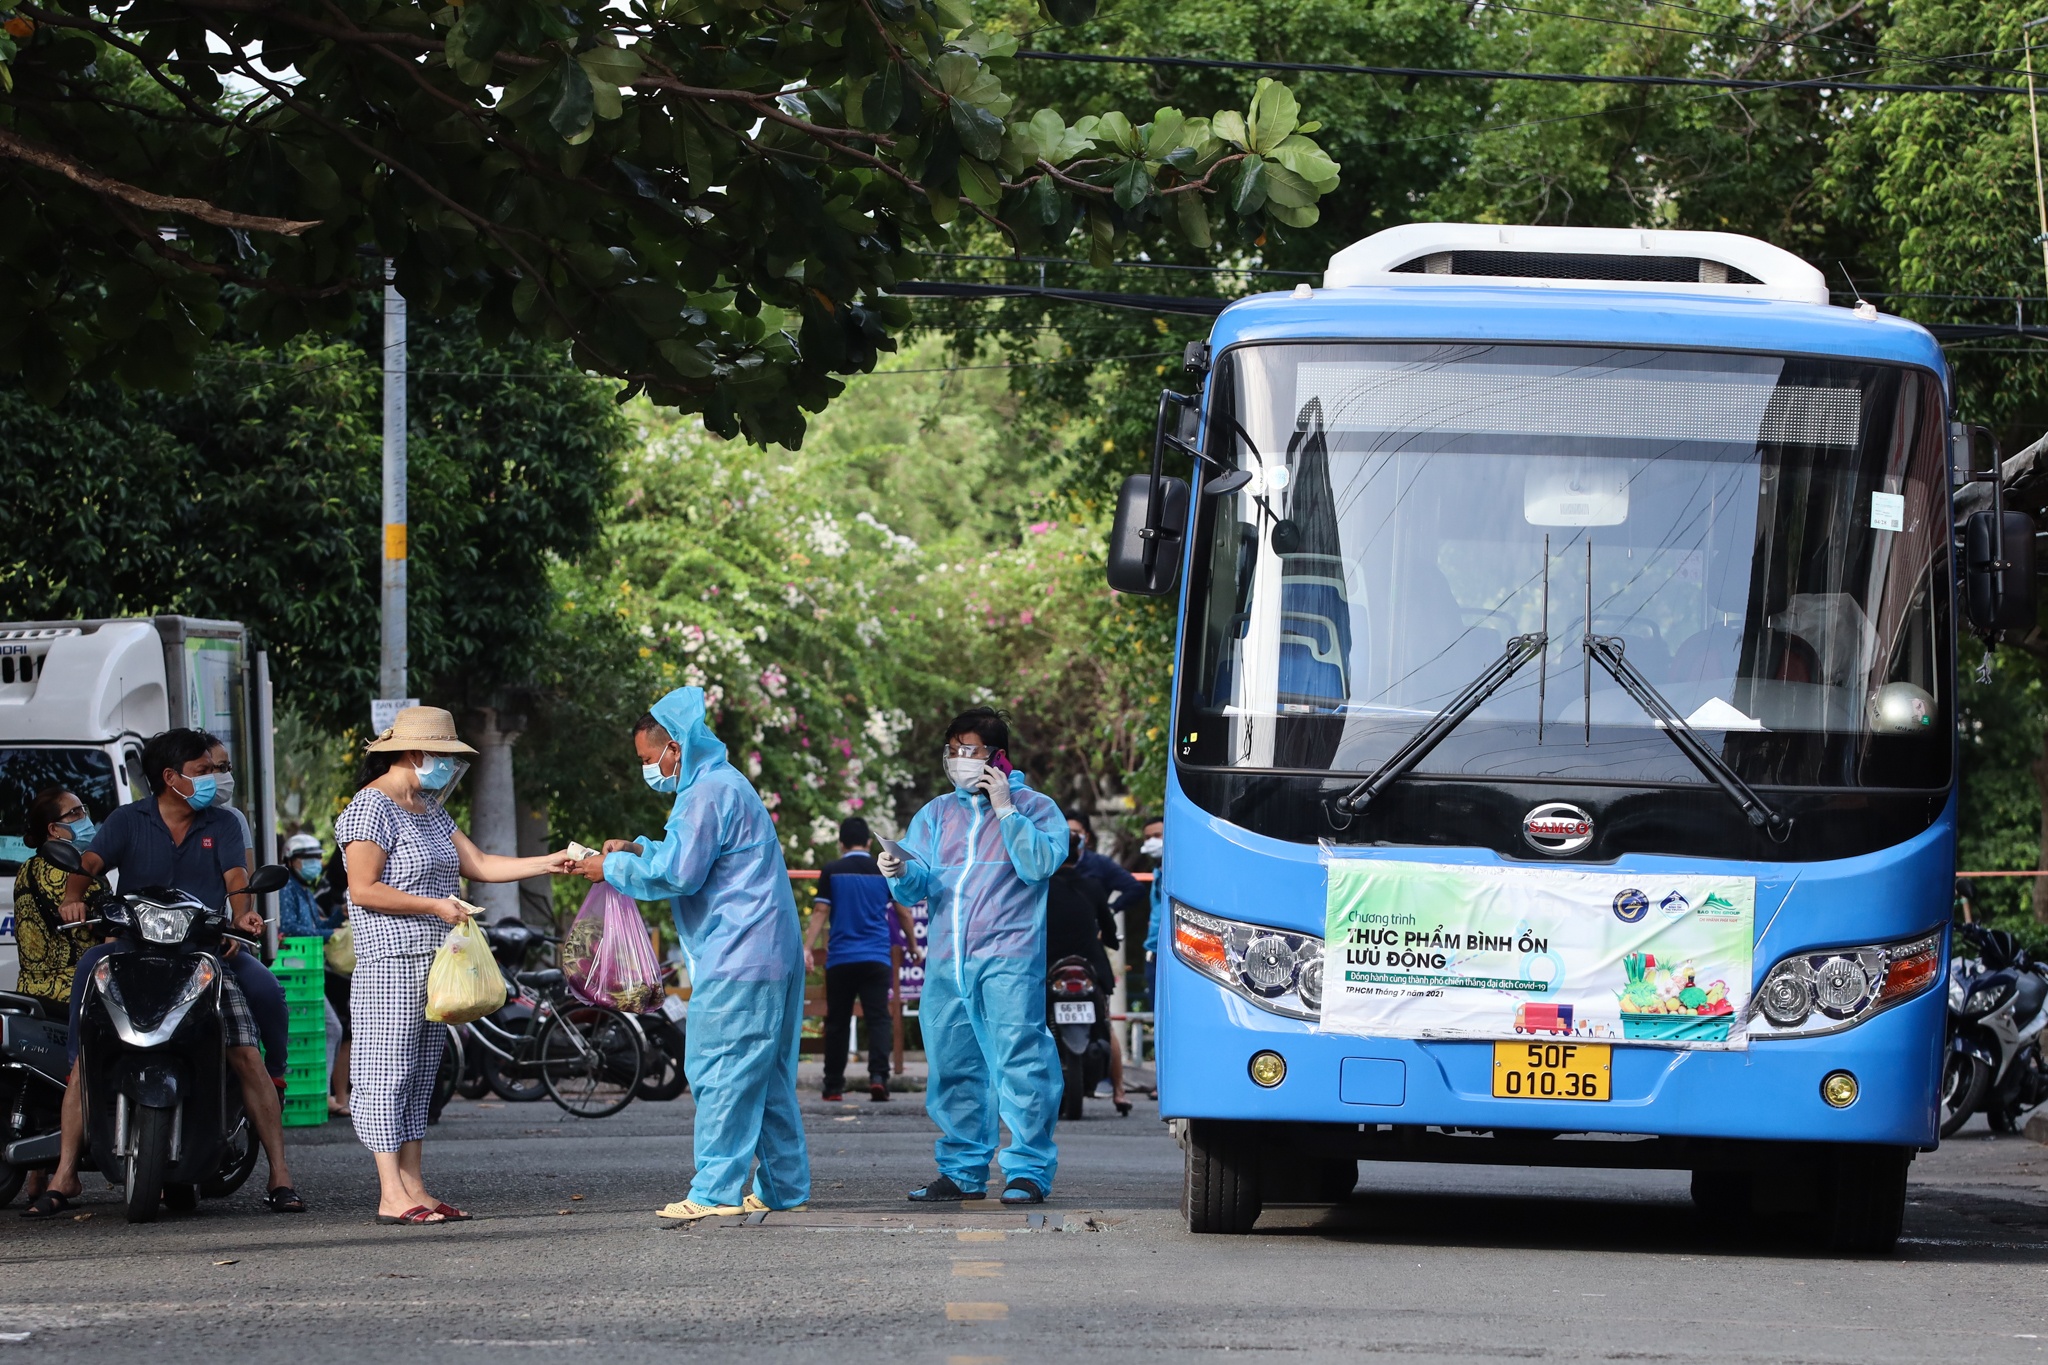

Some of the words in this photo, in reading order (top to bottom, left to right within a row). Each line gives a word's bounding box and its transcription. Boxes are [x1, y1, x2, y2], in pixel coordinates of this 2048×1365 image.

[0, 645, 27, 655] DAI
[1529, 820, 1589, 835] SAMCO
[1348, 910, 1388, 927] Chương
[1391, 912, 1416, 925] trình
[1348, 928, 1398, 949] THỰC
[1405, 924, 1460, 949] PHẨM
[1467, 931, 1512, 952] BÌNH
[1518, 929, 1548, 953] ỔN
[1347, 948, 1380, 966] LƯU
[1386, 948, 1446, 972] ĐỘNG
[899, 966, 925, 980] HO
[1350, 972, 1369, 982] Đồng
[1370, 973, 1388, 982] hành
[1390, 974, 1406, 984] cùng
[1408, 974, 1428, 984] thành
[1429, 975, 1443, 985] phố
[1514, 981, 1546, 991] Covid-19
[1346, 986, 1373, 994] TP.HCM
[1375, 988, 1398, 997] Tháng
[1528, 1045, 1577, 1068] 50F
[1506, 1071, 1597, 1096] 010.36
